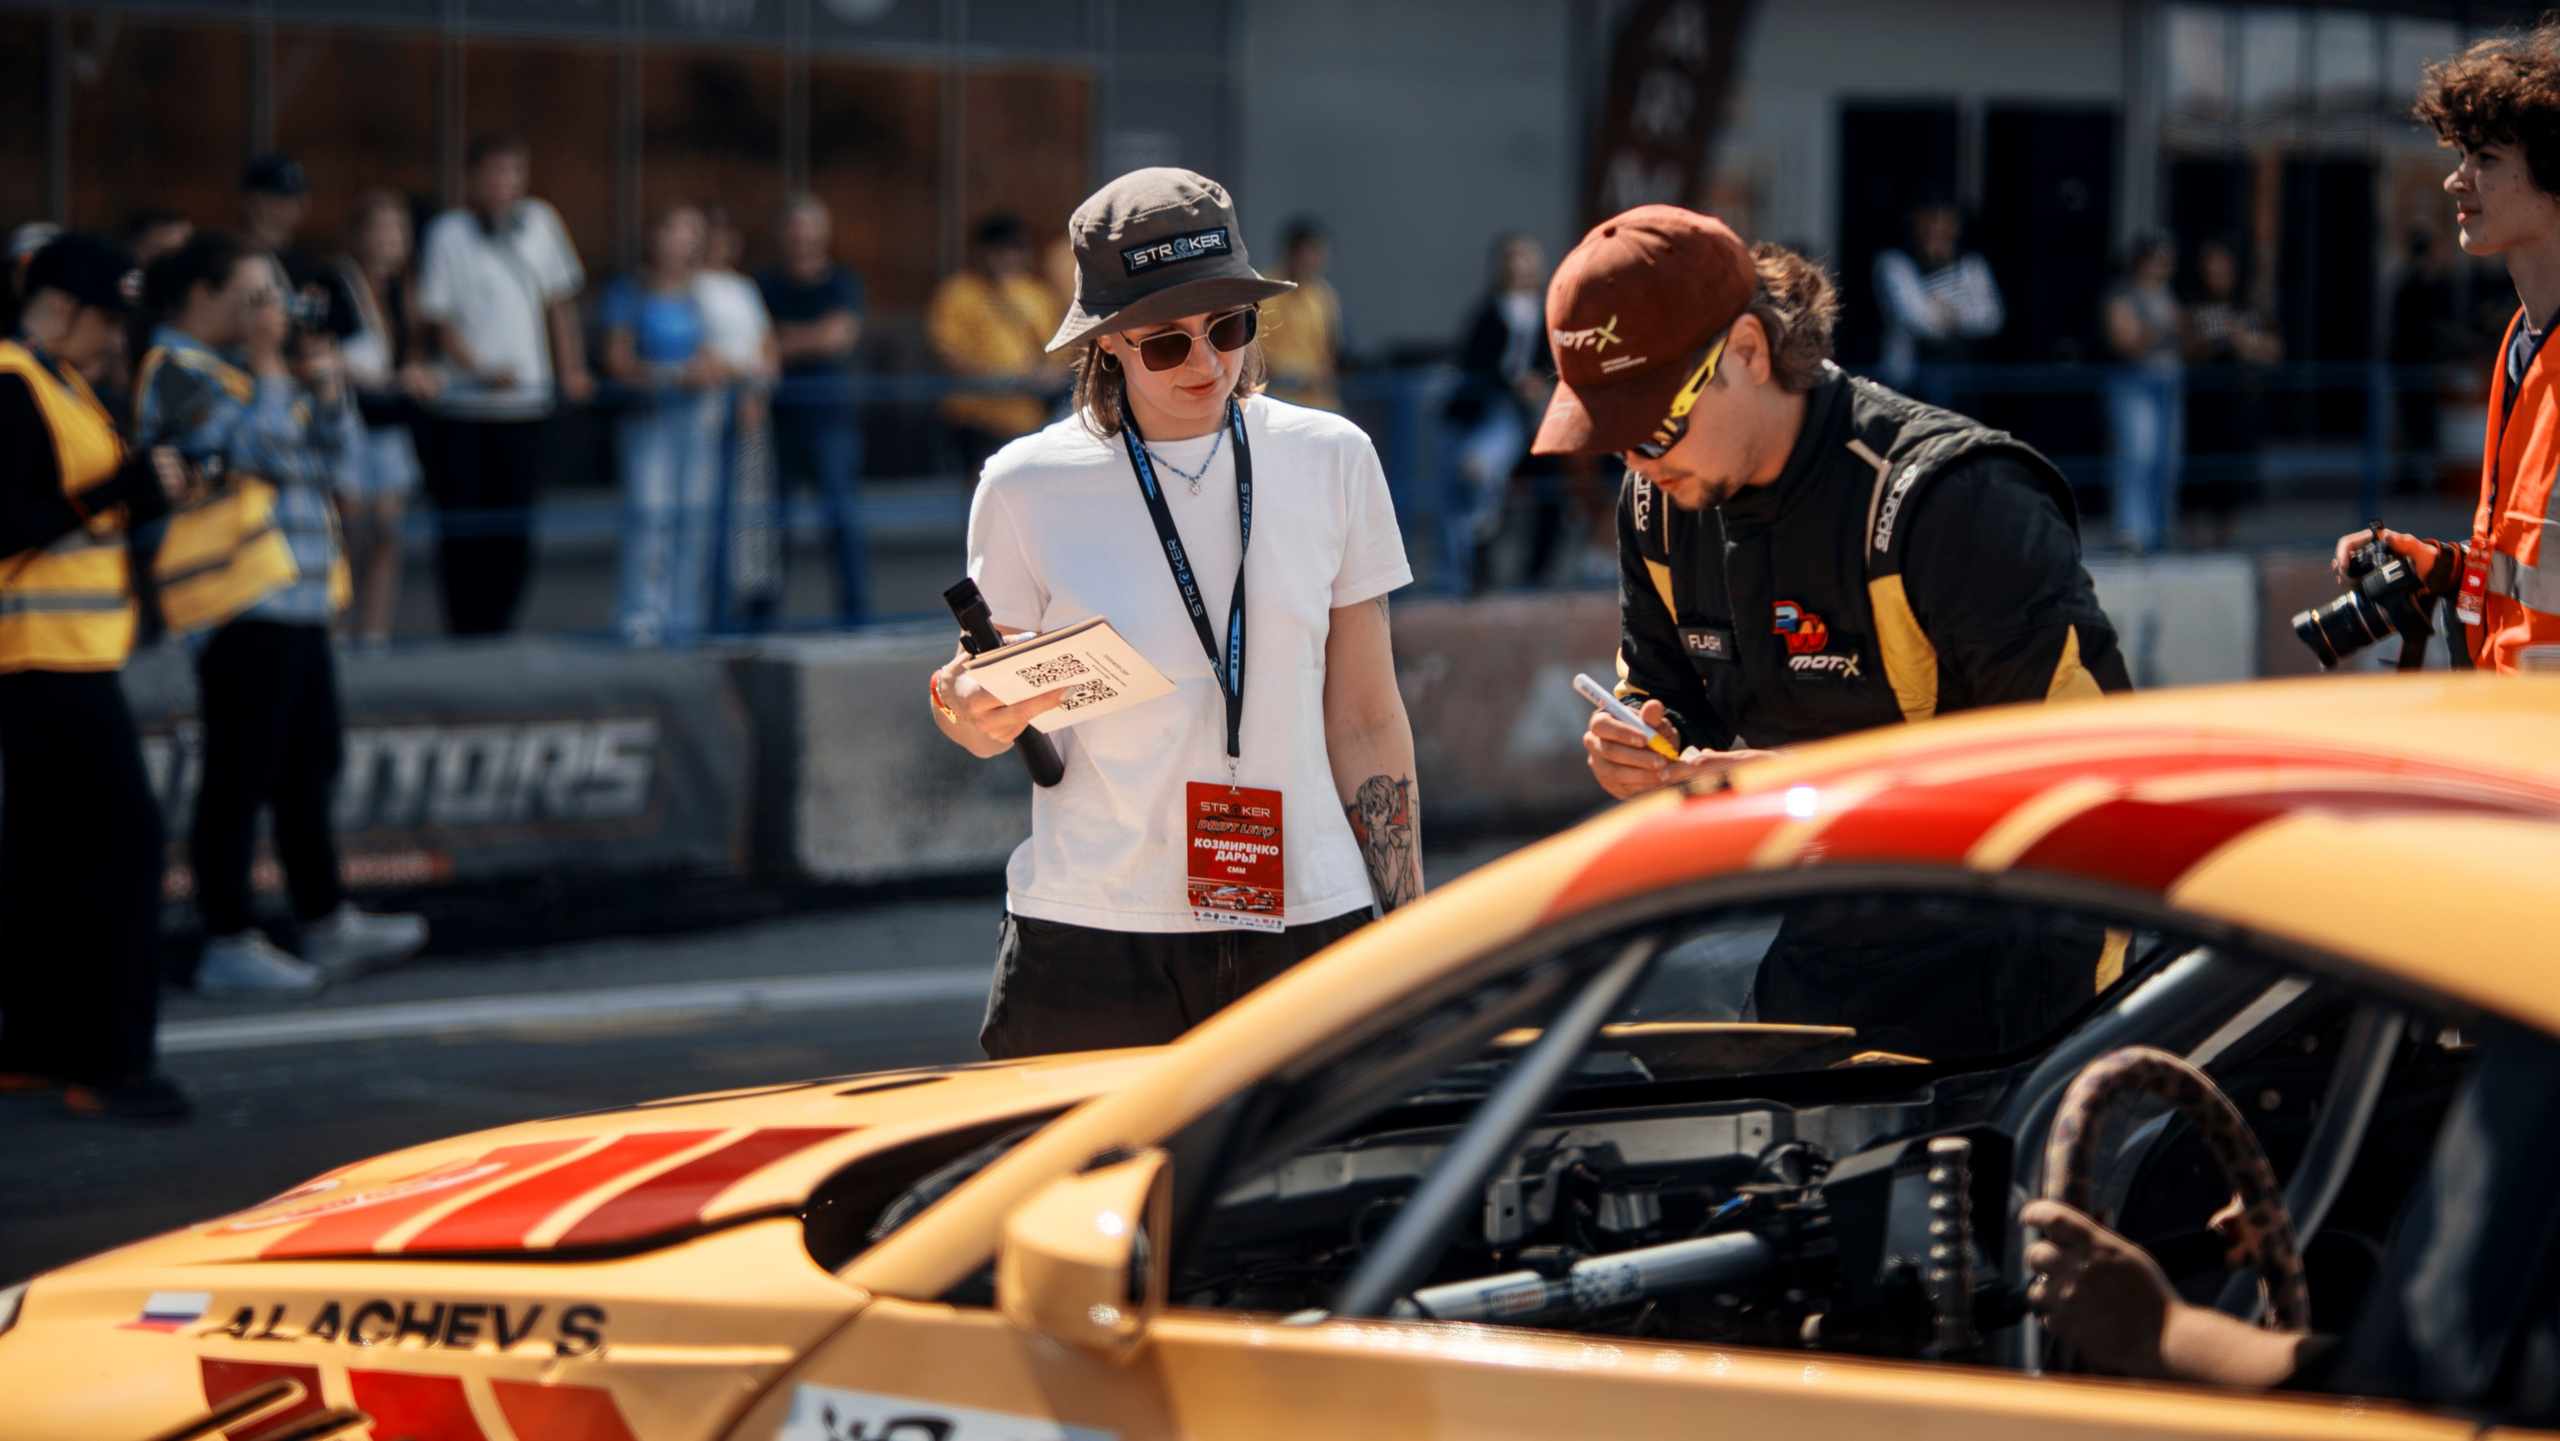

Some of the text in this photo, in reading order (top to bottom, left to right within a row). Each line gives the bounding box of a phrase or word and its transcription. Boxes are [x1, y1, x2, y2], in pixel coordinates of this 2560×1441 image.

[1133, 233, 1222, 266] STROKER
[1166, 538, 1204, 618] STROKER
[1201, 801, 1270, 817] STROKER
[1196, 819, 1276, 838] DRIFT LETO
[1195, 837, 1279, 855] КОЗМИРЕНКО
[1215, 850, 1257, 864] ДАРЬЯ
